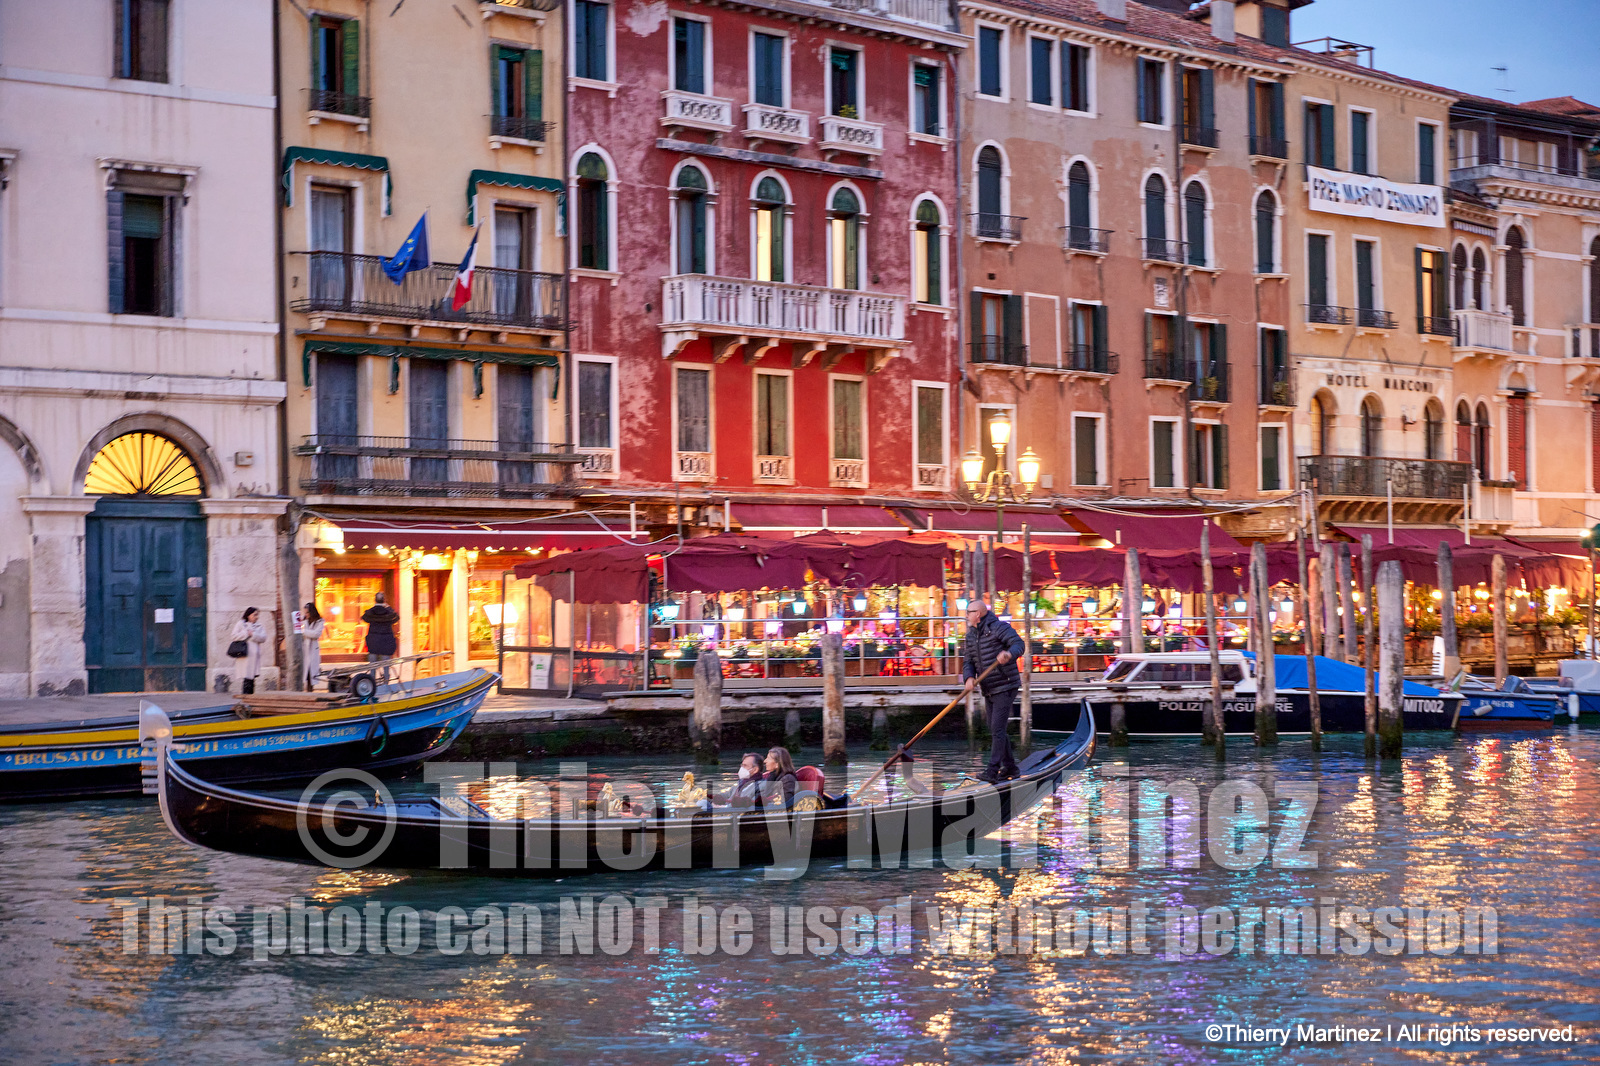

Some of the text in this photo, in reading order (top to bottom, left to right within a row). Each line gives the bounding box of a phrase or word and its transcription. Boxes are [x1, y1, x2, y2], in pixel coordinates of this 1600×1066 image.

[1313, 177, 1340, 203] FREE
[1326, 374, 1433, 394] HOTEL MARCONI
[1159, 702, 1294, 713] POLIZI AGURE
[1403, 699, 1444, 713] MIT002
[14, 749, 105, 766] BRUSATO
